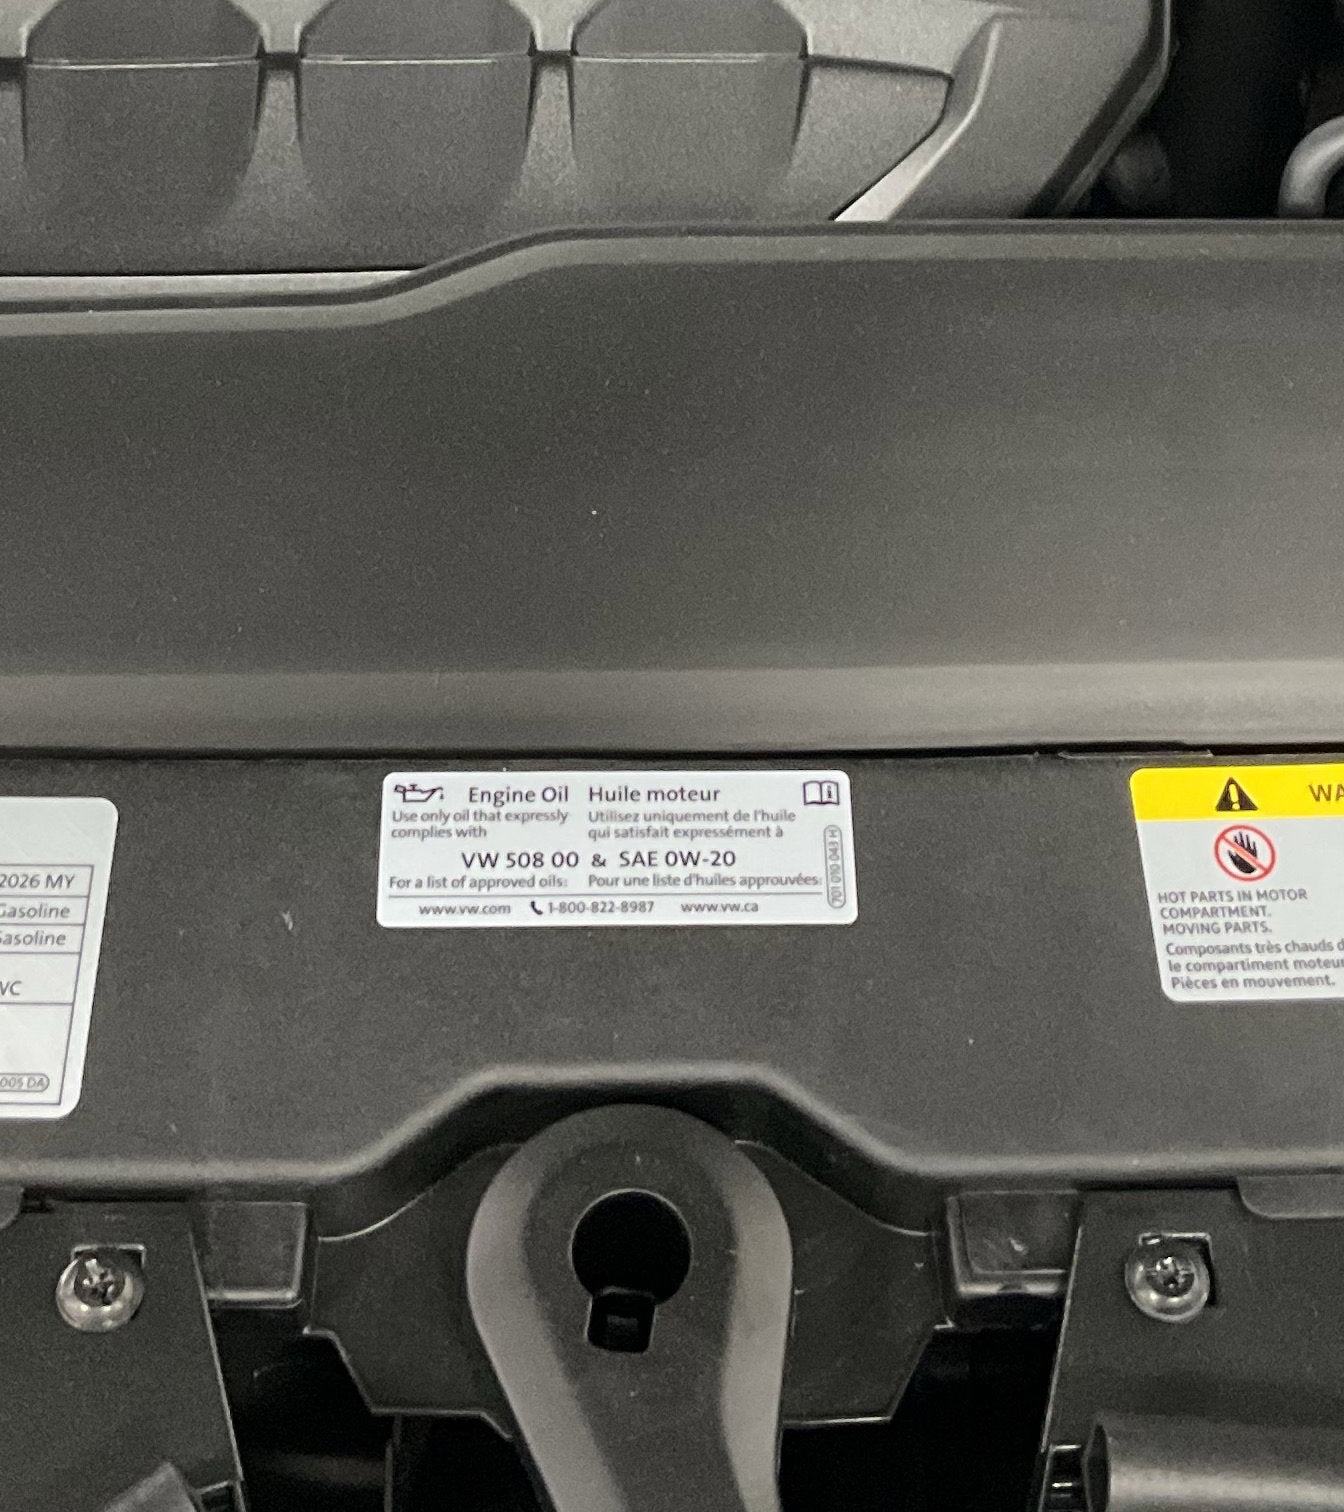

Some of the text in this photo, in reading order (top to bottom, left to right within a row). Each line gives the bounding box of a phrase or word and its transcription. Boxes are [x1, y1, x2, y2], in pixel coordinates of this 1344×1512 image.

[468, 785, 569, 809] Engine Oil
[589, 785, 721, 802] Huile moteur
[392, 808, 569, 826] Use only oil that expressly
[588, 809, 797, 826] Utilisez uniquement de l'huile
[390, 825, 488, 842] complies with
[587, 823, 784, 842] qui satisfait expressément à
[461, 850, 736, 869] VW 508 00 & SAE 0W-20
[45, 873, 76, 889] MY
[389, 874, 568, 891] For a list of approved oils:
[588, 872, 822, 890] Pour une liste d'huiles approuvées:
[1157, 887, 1308, 904] HOT PARTS IN MOTOR
[418, 904, 511, 915] www.vw.com
[548, 900, 655, 914] 1-800-822-8987
[680, 902, 759, 913] www.vw.ca
[1159, 905, 1272, 920] COMPARTMENT.
[1162, 920, 1273, 935] MOVING PARTS.
[1165, 942, 1253, 958] Composants
[1254, 940, 1283, 954] très
[1284, 939, 1335, 954] chauds
[1167, 959, 1182, 973] le
[1185, 958, 1290, 975] compartiment
[1170, 974, 1336, 990] Pièces en mouvement.
